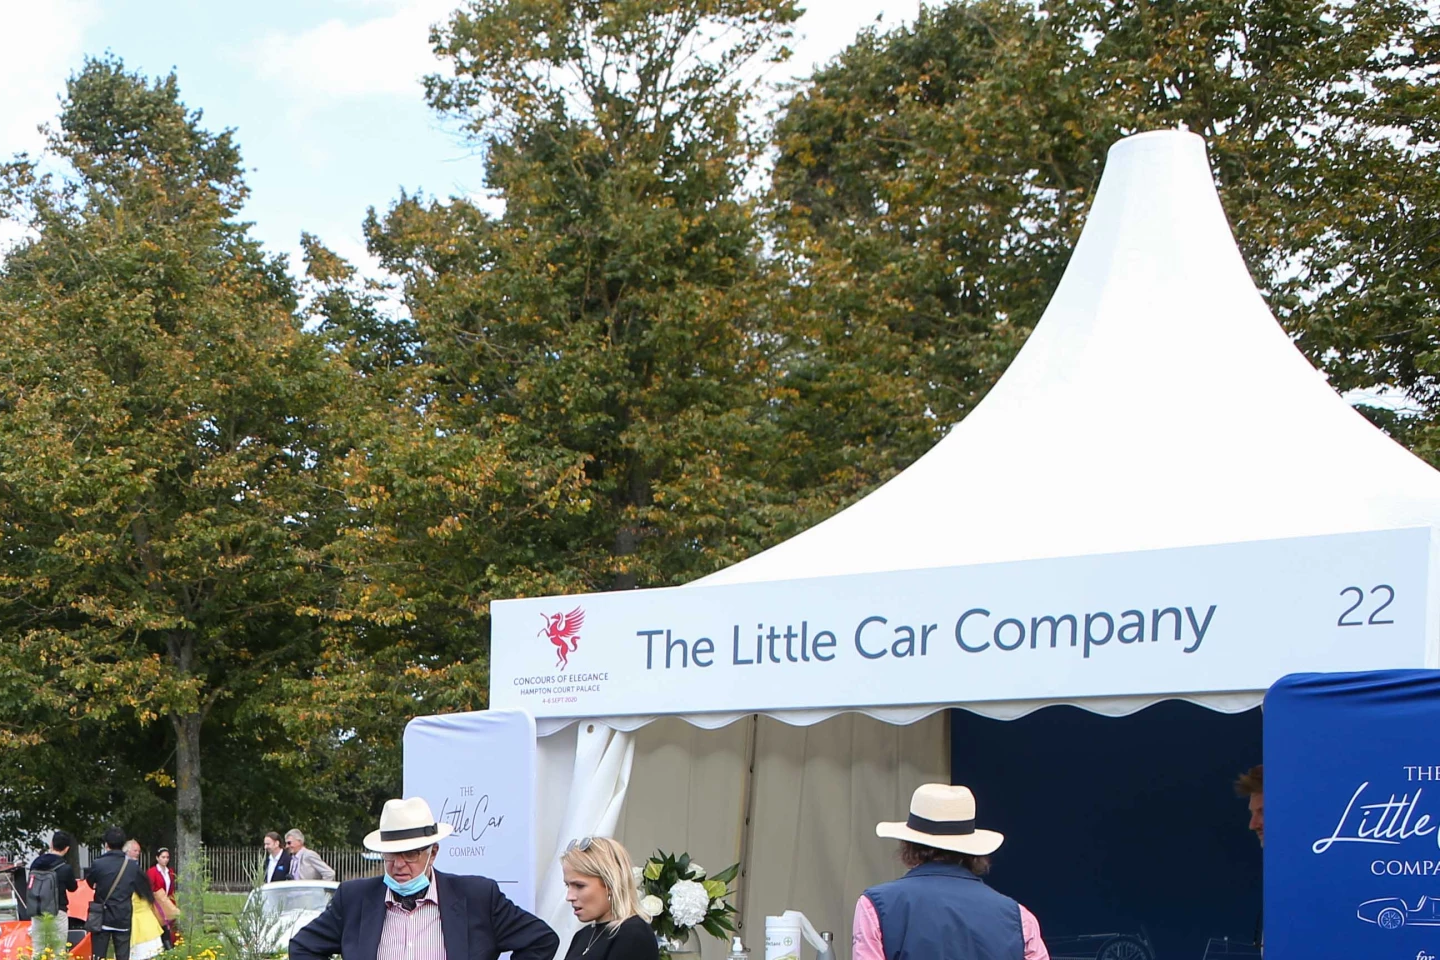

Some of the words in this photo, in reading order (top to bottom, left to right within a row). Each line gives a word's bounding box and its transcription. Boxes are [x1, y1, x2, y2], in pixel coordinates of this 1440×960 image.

[1337, 584, 1395, 627] 22
[636, 629, 715, 670] The
[732, 620, 837, 665] Little
[854, 615, 938, 660] Car
[954, 604, 1217, 659] Company
[513, 675, 556, 686] CONCOURS
[557, 674, 567, 683] OF
[569, 672, 609, 683] ELEGANCE
[520, 687, 552, 696] HAMPTON
[553, 685, 575, 694] COURT
[576, 684, 600, 693] PALACE
[1403, 766, 1440, 781] THE
[460, 786, 474, 797] THE
[471, 794, 505, 842] Car
[1312, 781, 1436, 854] Little
[449, 846, 486, 857] COMPANY
[1370, 860, 1440, 876] COMPA
